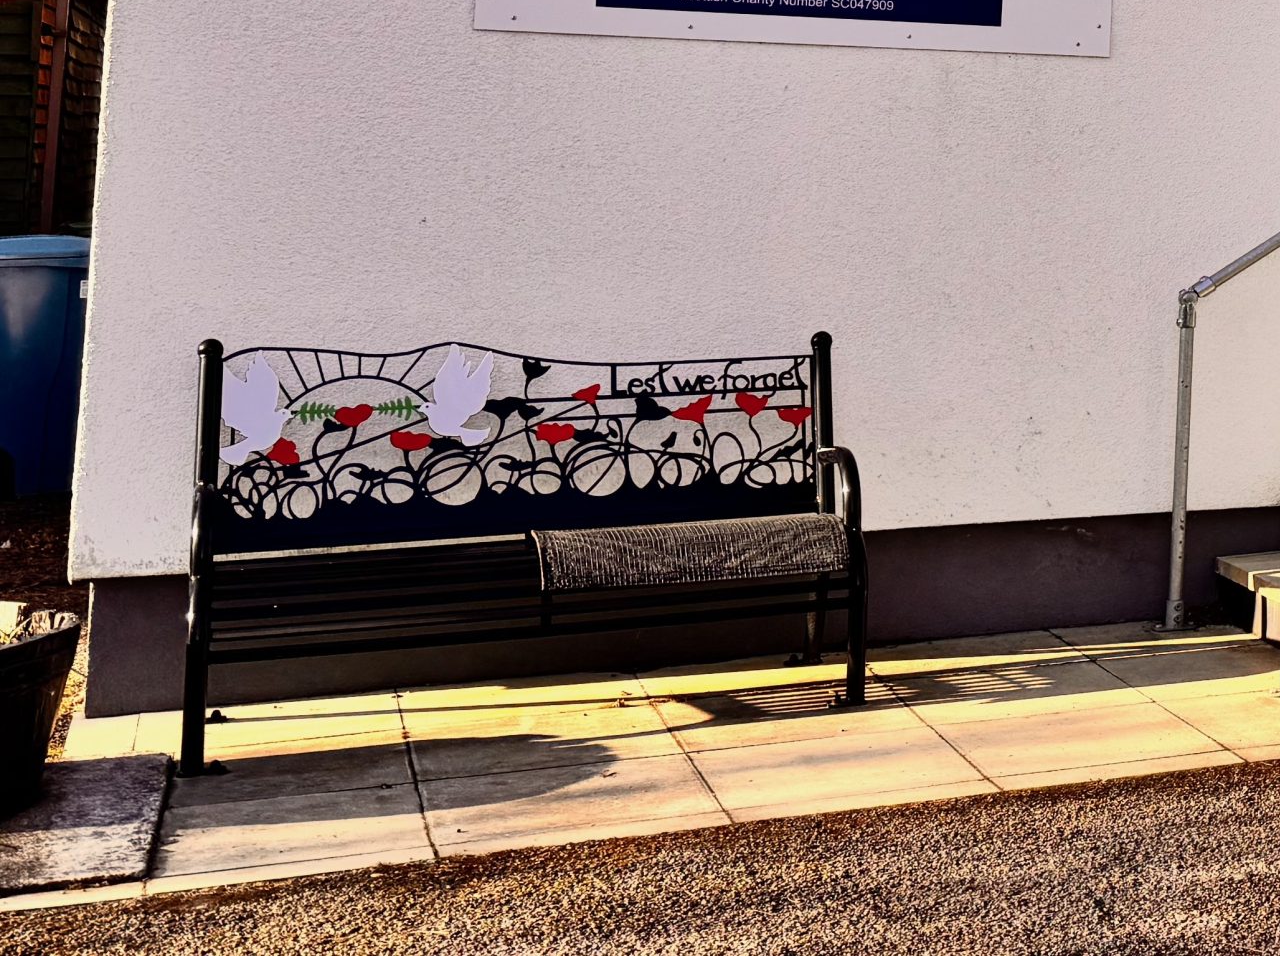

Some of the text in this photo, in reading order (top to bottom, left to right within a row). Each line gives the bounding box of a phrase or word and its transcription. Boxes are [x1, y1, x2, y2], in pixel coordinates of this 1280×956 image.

[611, 359, 808, 400] Lest we forget
